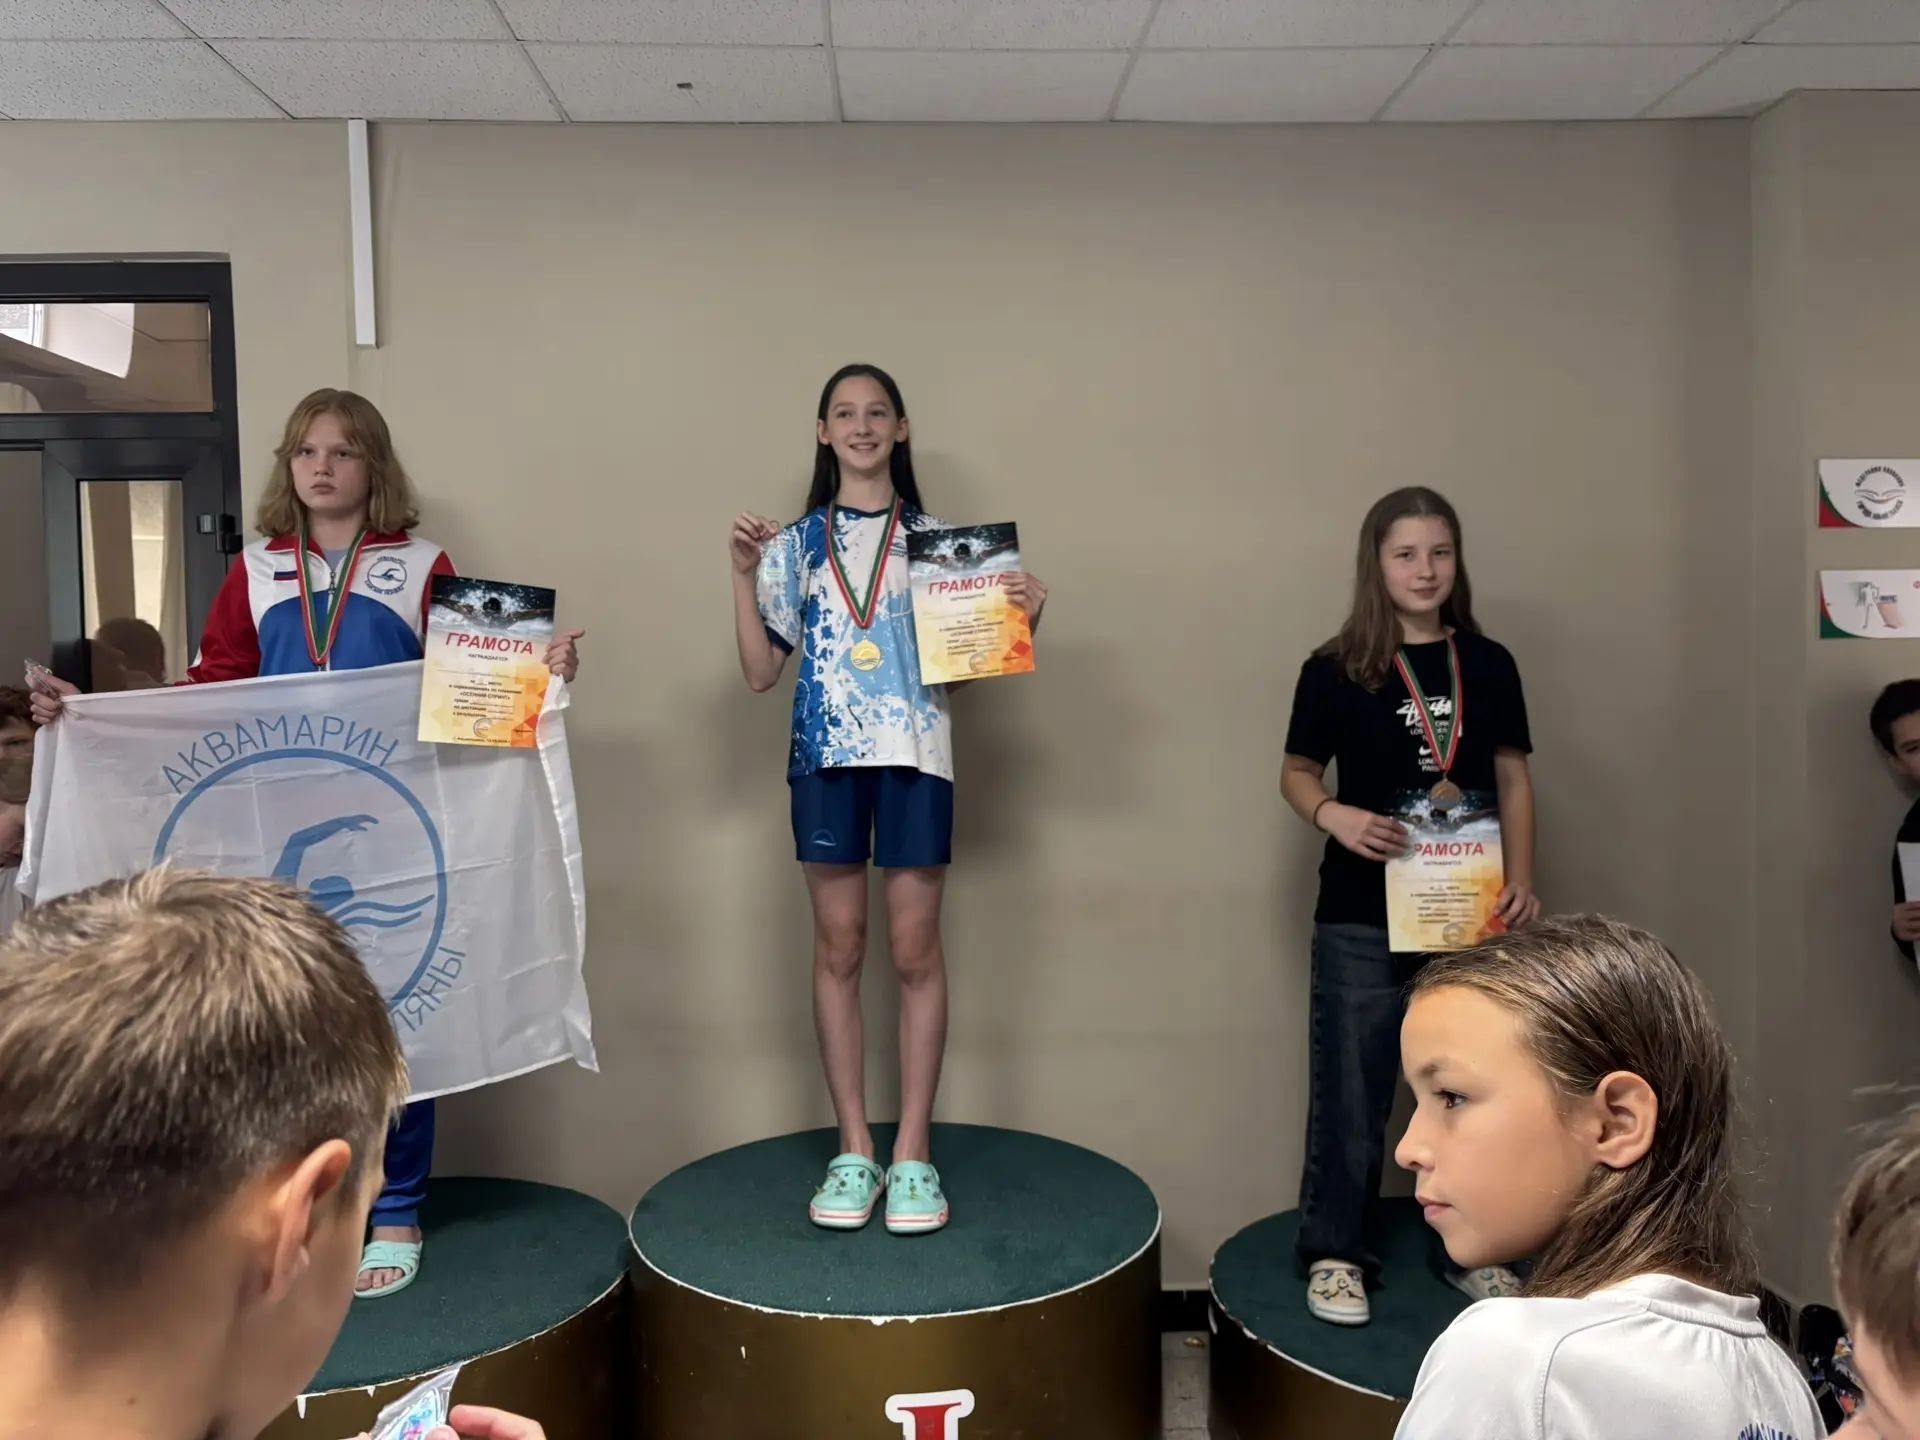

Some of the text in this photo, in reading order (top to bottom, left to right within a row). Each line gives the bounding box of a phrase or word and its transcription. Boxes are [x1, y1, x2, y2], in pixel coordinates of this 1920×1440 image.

[445, 632, 533, 655] ГРАМОТА
[161, 714, 399, 795] АКВАМАРИН
[1413, 842, 1484, 857] РАМОТА
[391, 946, 466, 1033] ЛЯНЫ
